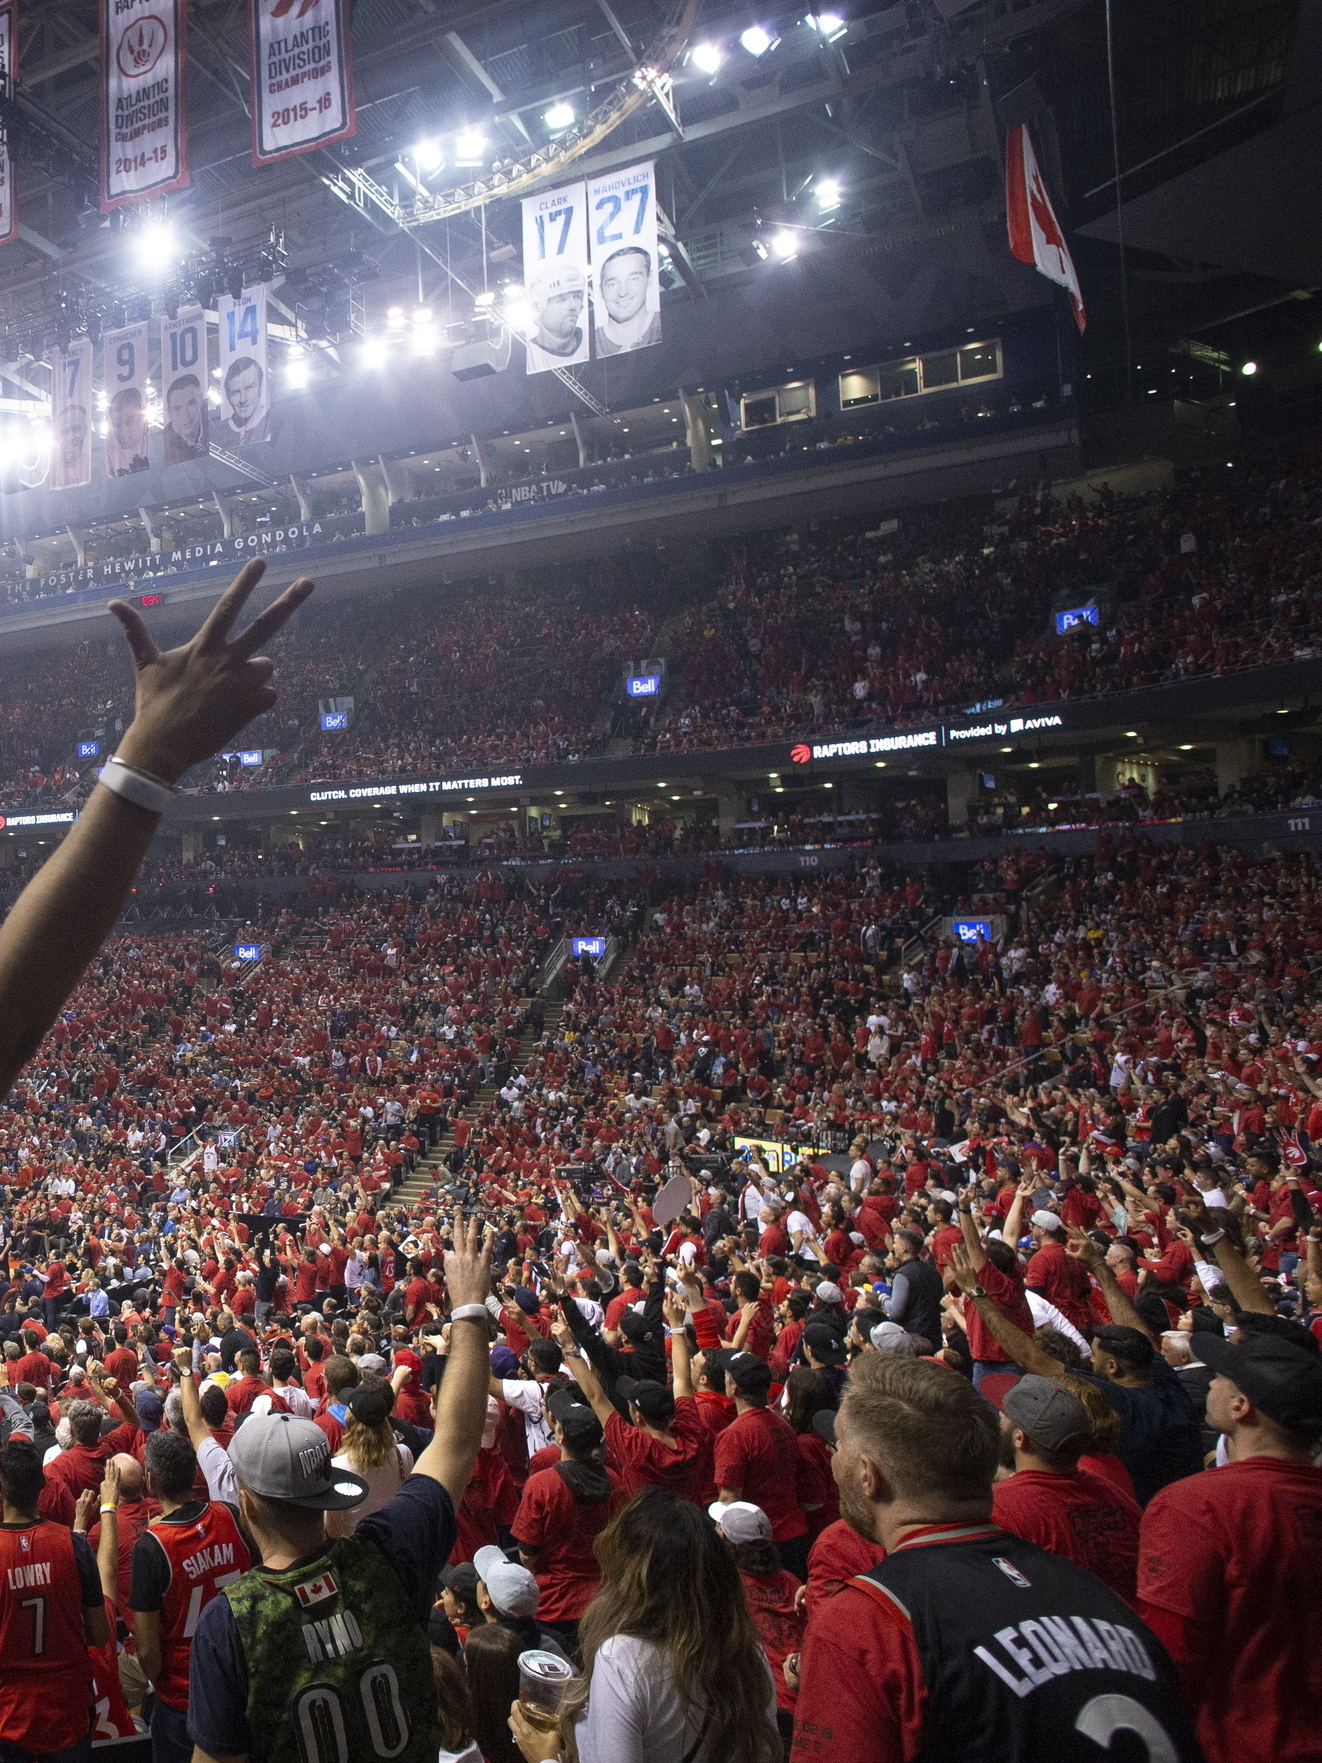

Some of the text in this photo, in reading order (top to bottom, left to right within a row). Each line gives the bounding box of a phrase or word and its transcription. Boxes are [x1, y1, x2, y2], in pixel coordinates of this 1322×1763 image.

[268, 21, 329, 59] ATLANTIC
[268, 40, 331, 80] DIVISION
[269, 61, 332, 94] CHAMPIONS
[115, 78, 169, 112] ATLANTIC
[115, 95, 169, 130] DIVISION
[271, 91, 332, 128] 2015-16
[115, 116, 169, 143] CHAMPIONS
[115, 145, 167, 175] 2014-15
[594, 172, 649, 196] MAHOVLICH
[539, 195, 568, 211] CLARK
[595, 184, 650, 245] 27
[535, 206, 574, 261] 17
[164, 312, 204, 332] ARMSTRONG
[227, 304, 259, 352] 14
[116, 342, 135, 383] 9
[170, 326, 198, 372] 10
[63, 358, 80, 398] 7
[512, 480, 559, 502] NBA TV
[6, 522, 323, 595] THE FOSTER HEWITT MEDIA GONDOLA
[633, 679, 655, 694] Bell
[813, 715, 1063, 759] RAPTORS INSURANCE Provided by AVIVA
[243, 753, 258, 764] Bell
[310, 775, 523, 801] CLUTCH. COVERAGE WHEN IT MATTERS MOST.
[6, 812, 73, 826] RAPTORS INSURANCE
[1288, 818, 1310, 832] 111
[798, 855, 818, 867] 110
[238, 948, 256, 959] Bell
[7, 1562, 51, 1590] LOWRY
[183, 1543, 234, 1579] SIAKAM
[22, 1597, 44, 1654] 7
[301, 1610, 363, 1663] RYNO
[973, 1615, 1157, 1698] LEONARD
[298, 1664, 409, 1763] 00
